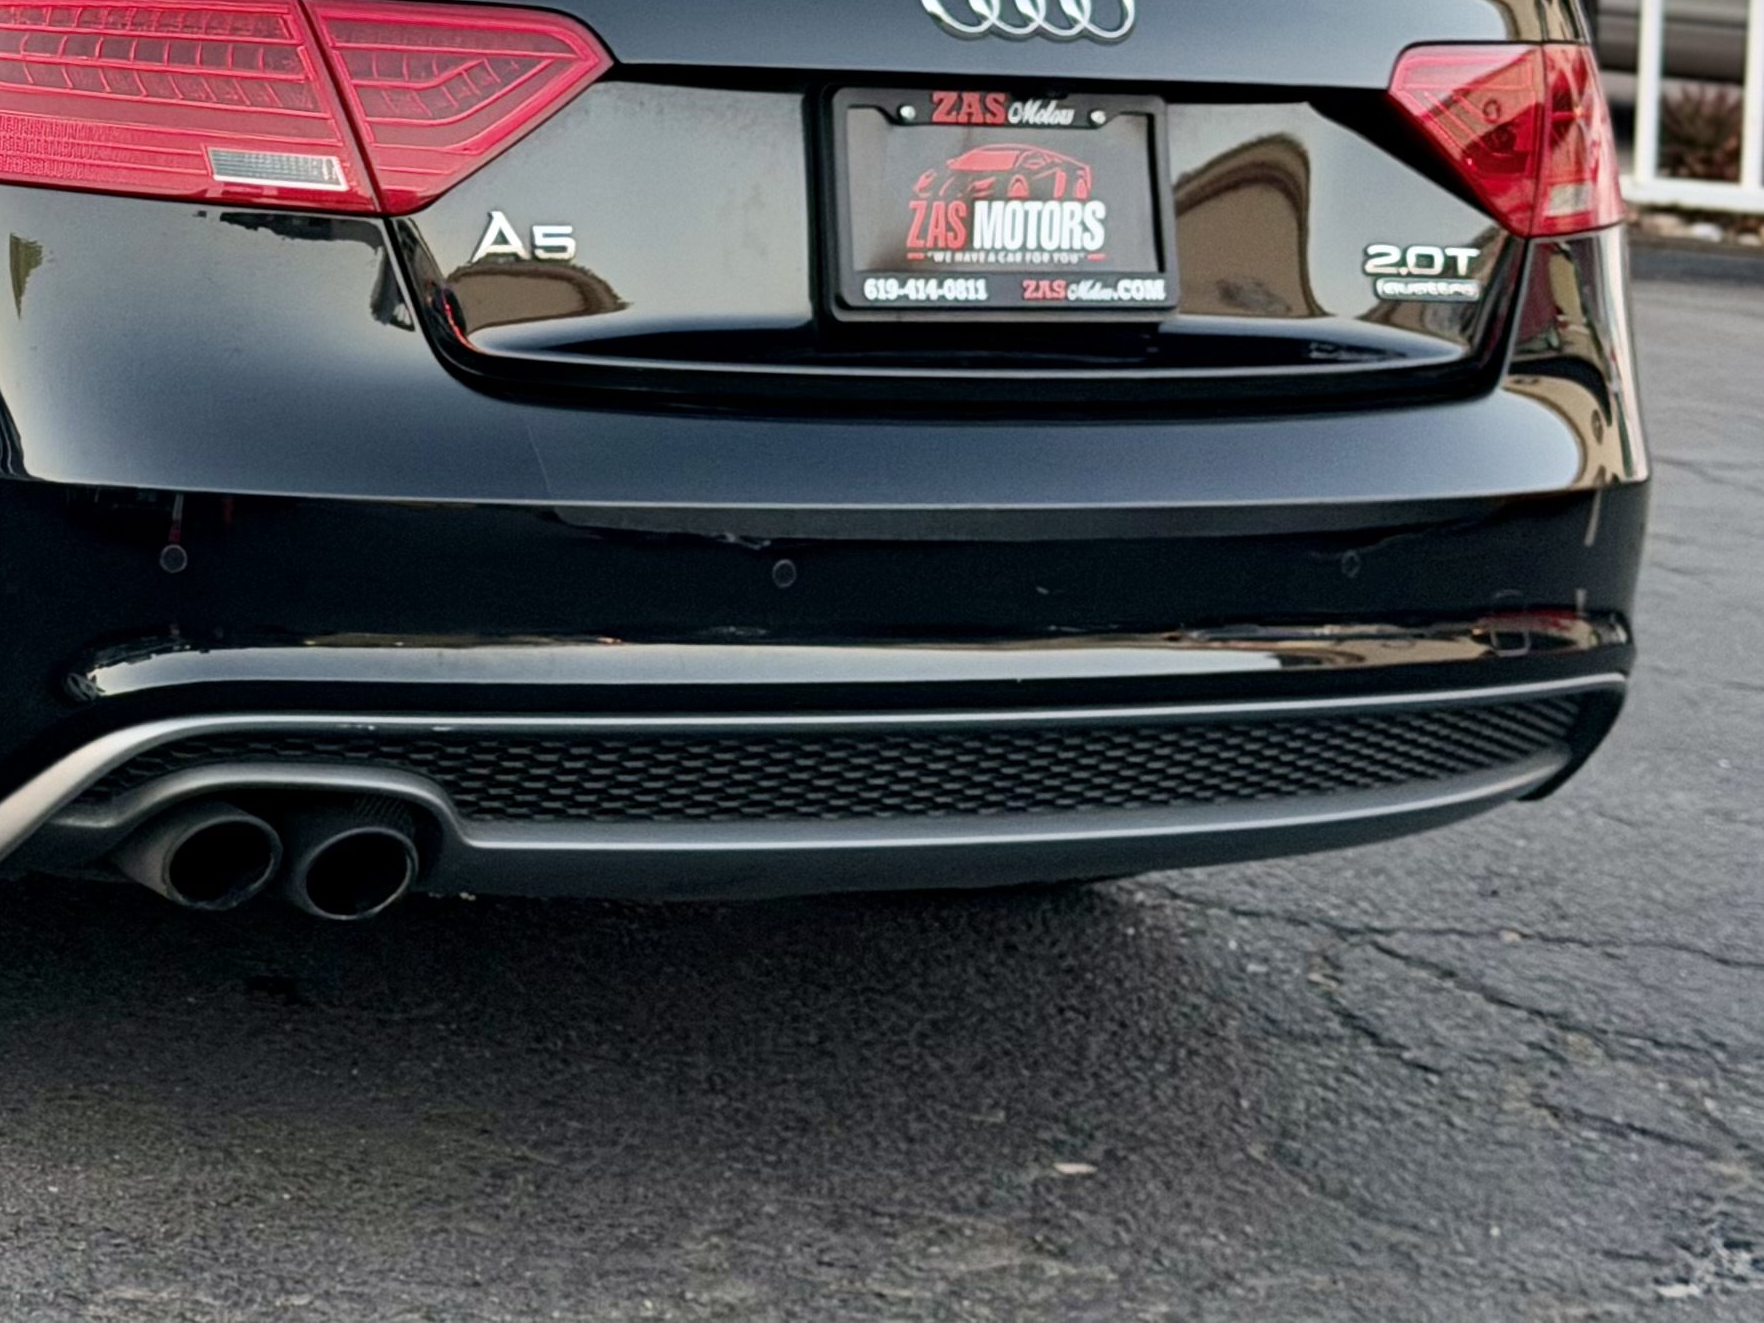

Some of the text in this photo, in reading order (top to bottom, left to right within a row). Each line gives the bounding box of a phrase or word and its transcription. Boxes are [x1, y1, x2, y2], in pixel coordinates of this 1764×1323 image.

[931, 91, 1008, 125] ZAS
[470, 209, 577, 264] A5
[906, 199, 1106, 251] ZAS MOTORS
[954, 251, 986, 264] HAVE
[988, 251, 996, 264] A
[998, 251, 1023, 264] CAR
[1025, 252, 1050, 265] FOR
[1363, 243, 1481, 276] 2.0T
[863, 277, 988, 301] 619-414-0811
